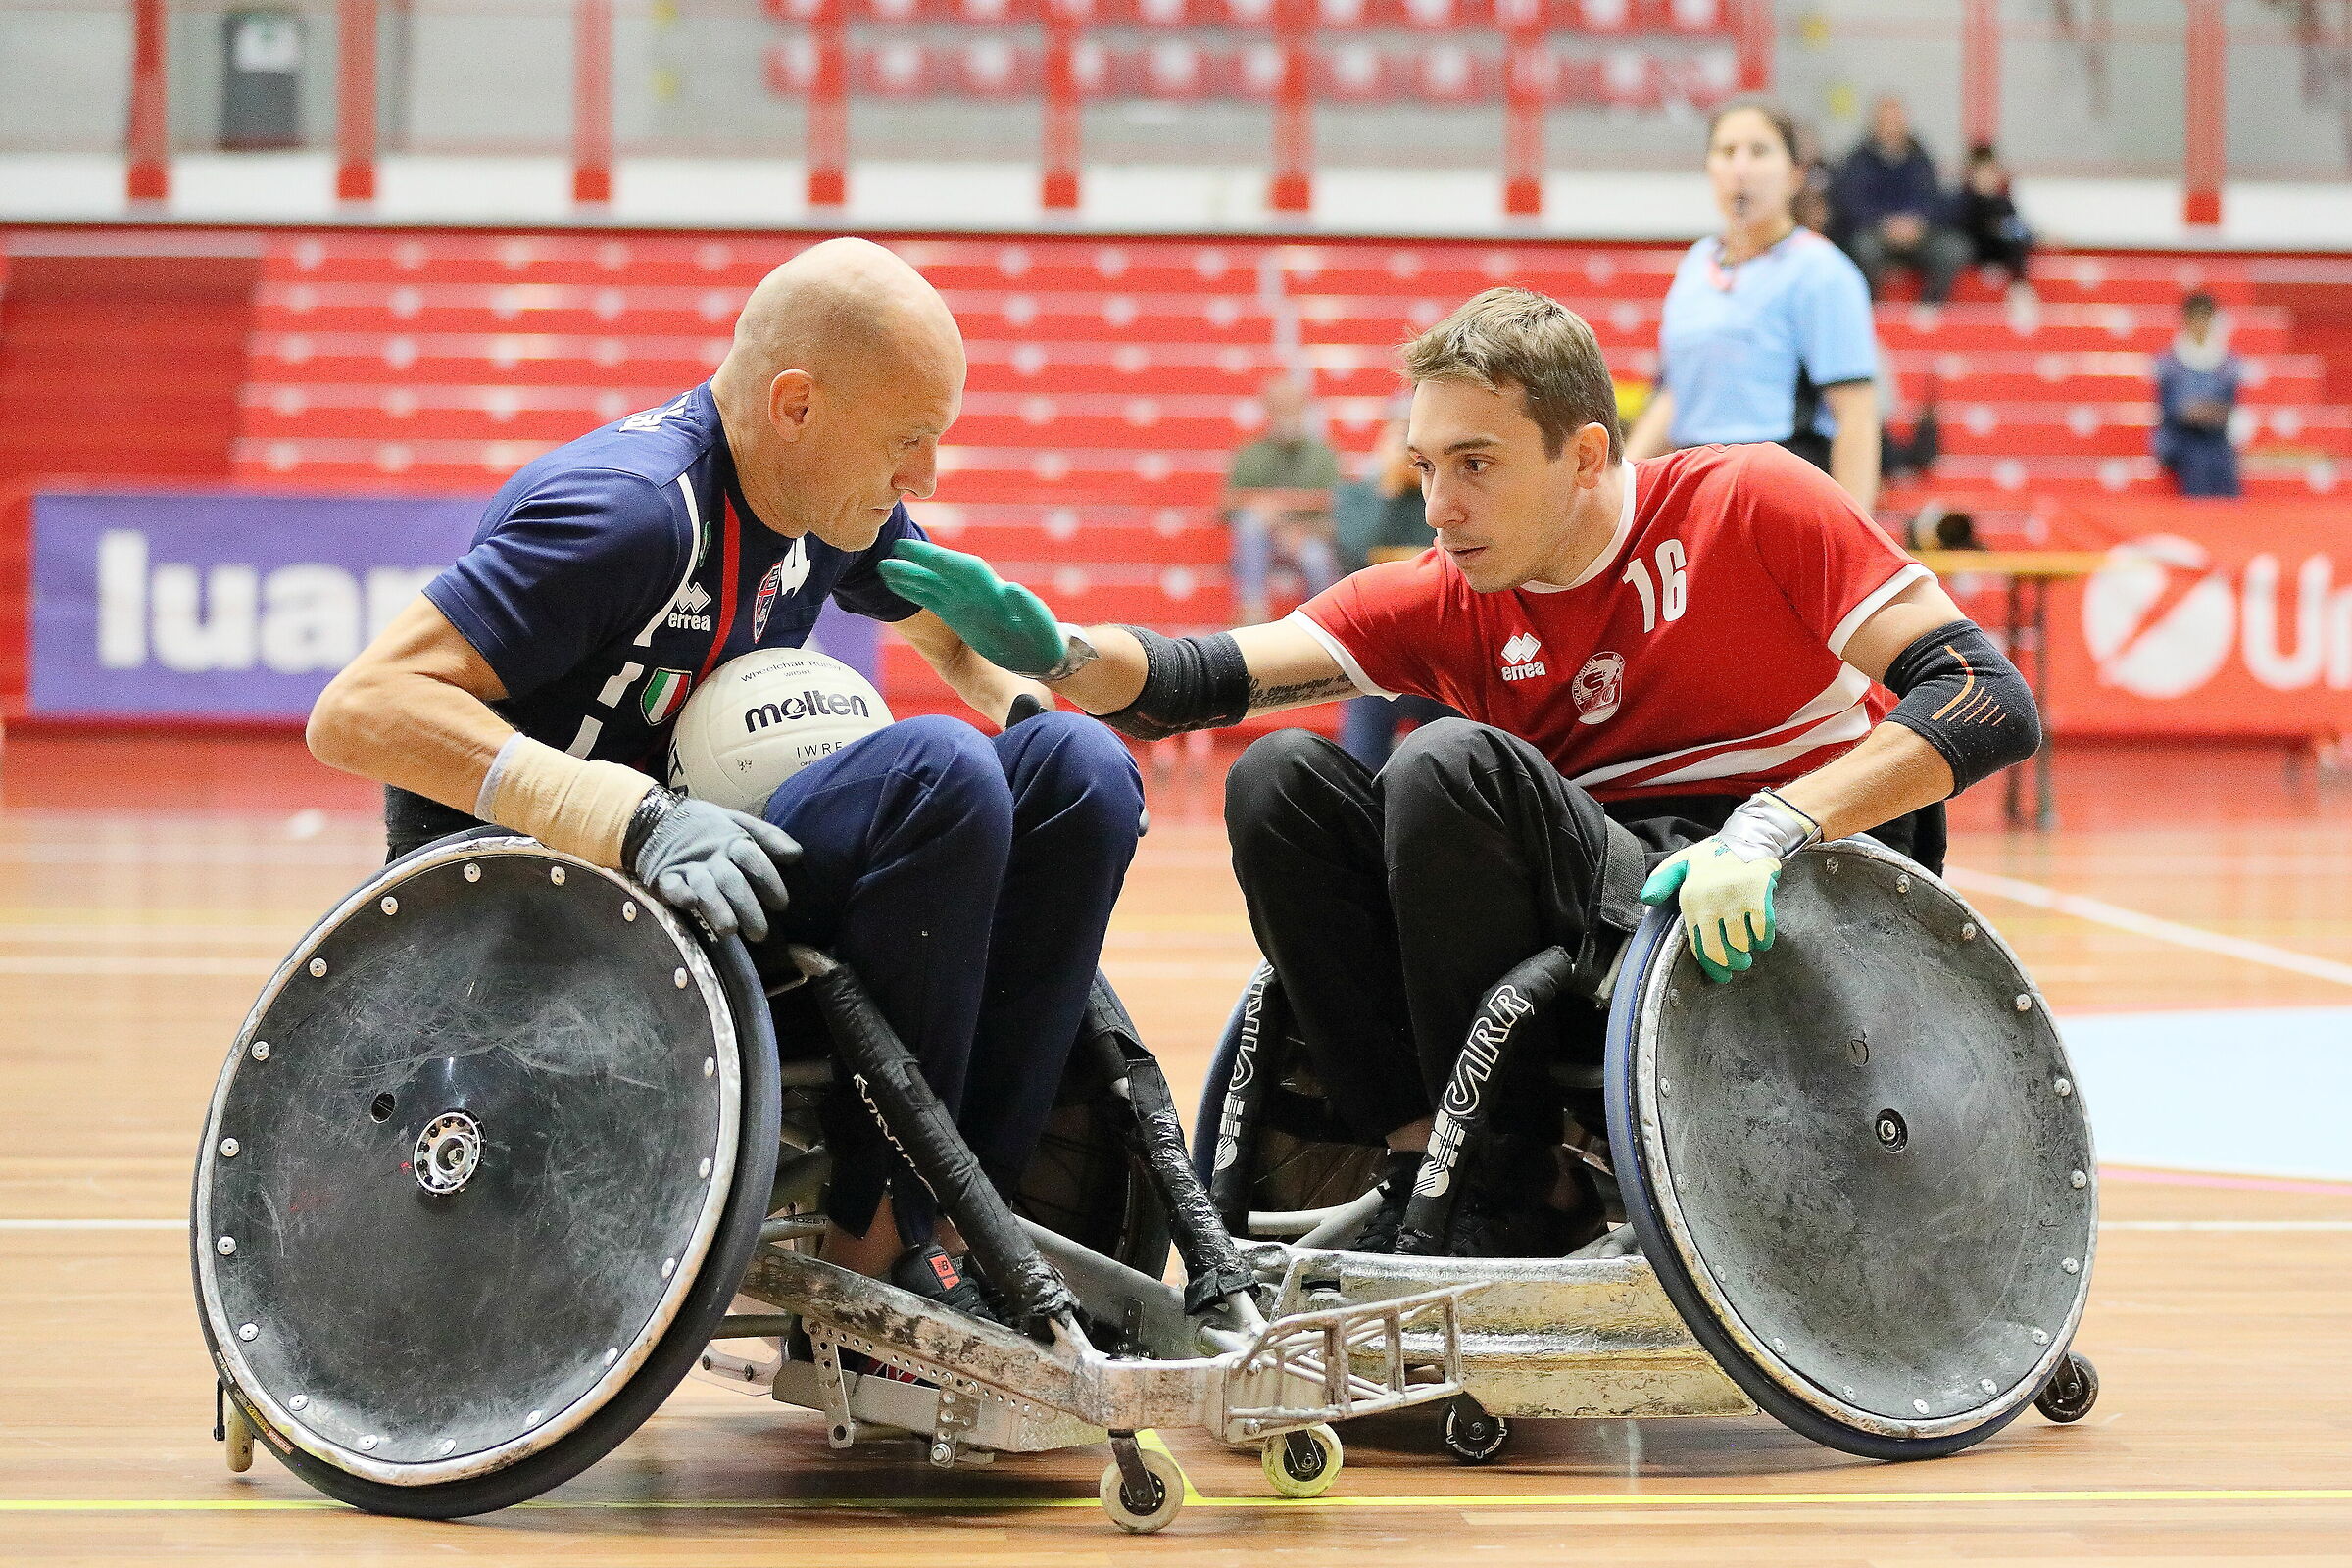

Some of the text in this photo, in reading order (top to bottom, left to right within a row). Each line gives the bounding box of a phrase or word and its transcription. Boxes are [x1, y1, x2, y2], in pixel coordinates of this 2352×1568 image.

[1622, 539, 1687, 634] 16
[740, 660, 805, 682] Wheelchair
[744, 690, 870, 733] molten
